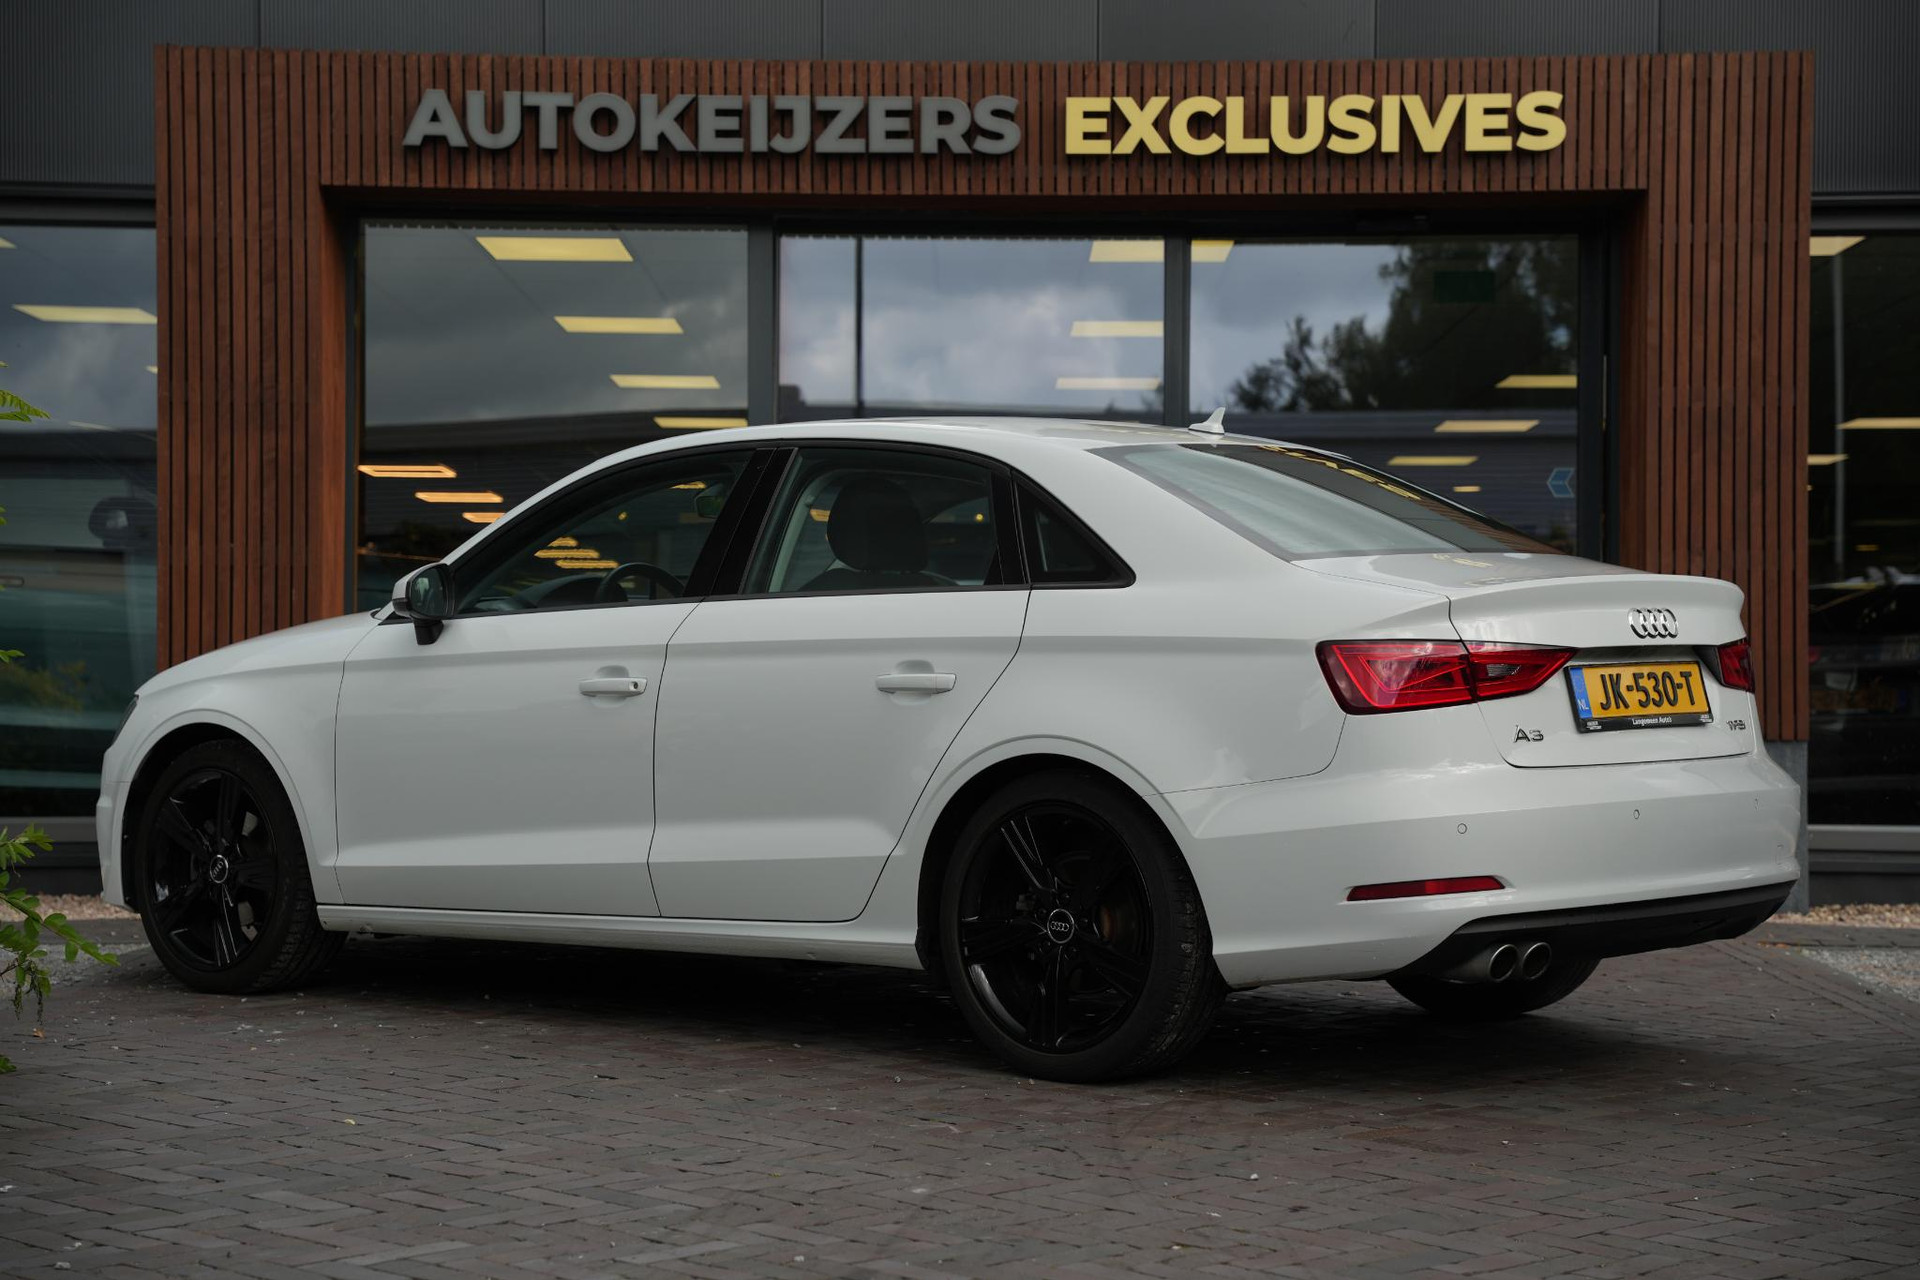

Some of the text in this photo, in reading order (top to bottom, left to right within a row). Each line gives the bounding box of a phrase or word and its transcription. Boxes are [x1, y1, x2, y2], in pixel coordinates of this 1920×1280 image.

[402, 89, 1567, 155] AUTOKEIJZERS EXCLUSIVES
[1577, 699, 1589, 711] NL
[1599, 671, 1695, 711] JK-530-T
[1514, 725, 1544, 743] A3
